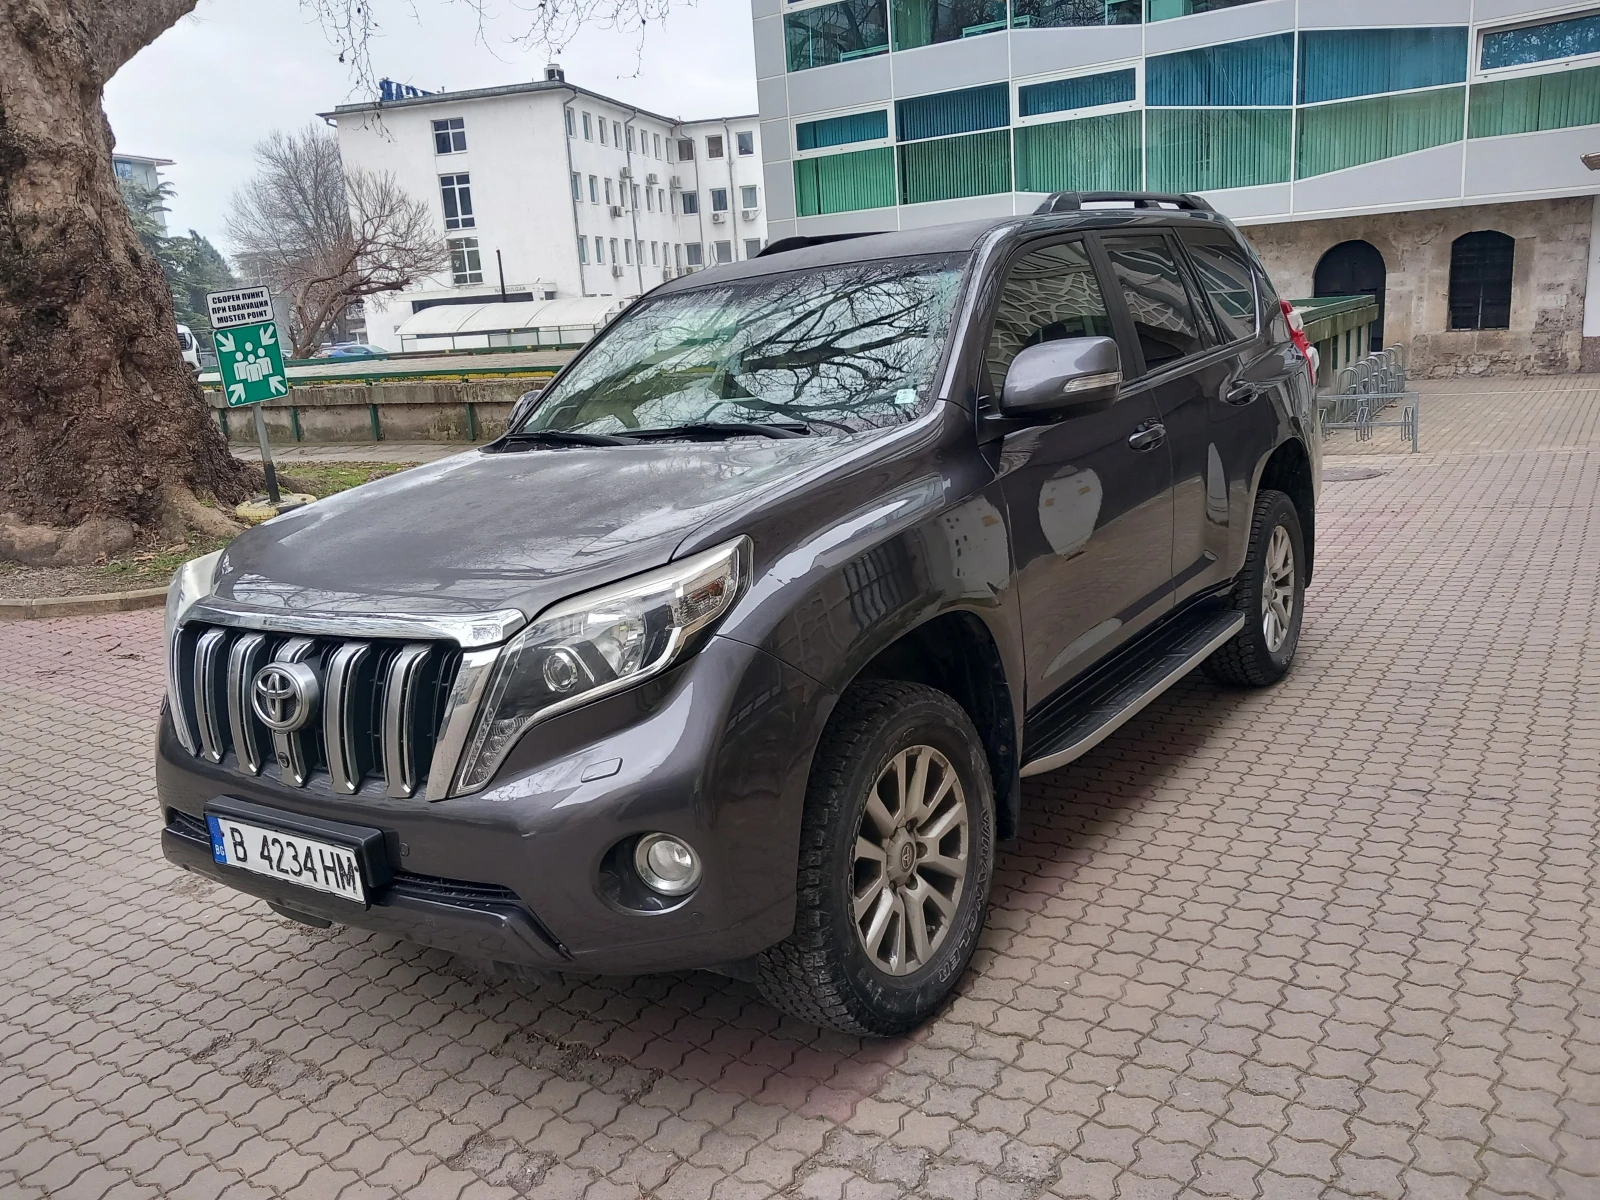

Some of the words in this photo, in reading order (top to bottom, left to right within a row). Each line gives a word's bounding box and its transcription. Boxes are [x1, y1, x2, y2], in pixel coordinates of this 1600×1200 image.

[212, 294, 241, 304] СБОРЕН
[242, 291, 264, 300] ПУНКТ
[212, 306, 227, 314] ПРИ
[228, 300, 268, 312] ЕВАКУАЦИЯ
[217, 313, 246, 324] MUSTER
[247, 310, 267, 319] POINT
[215, 844, 225, 855] BG
[229, 826, 248, 862] B
